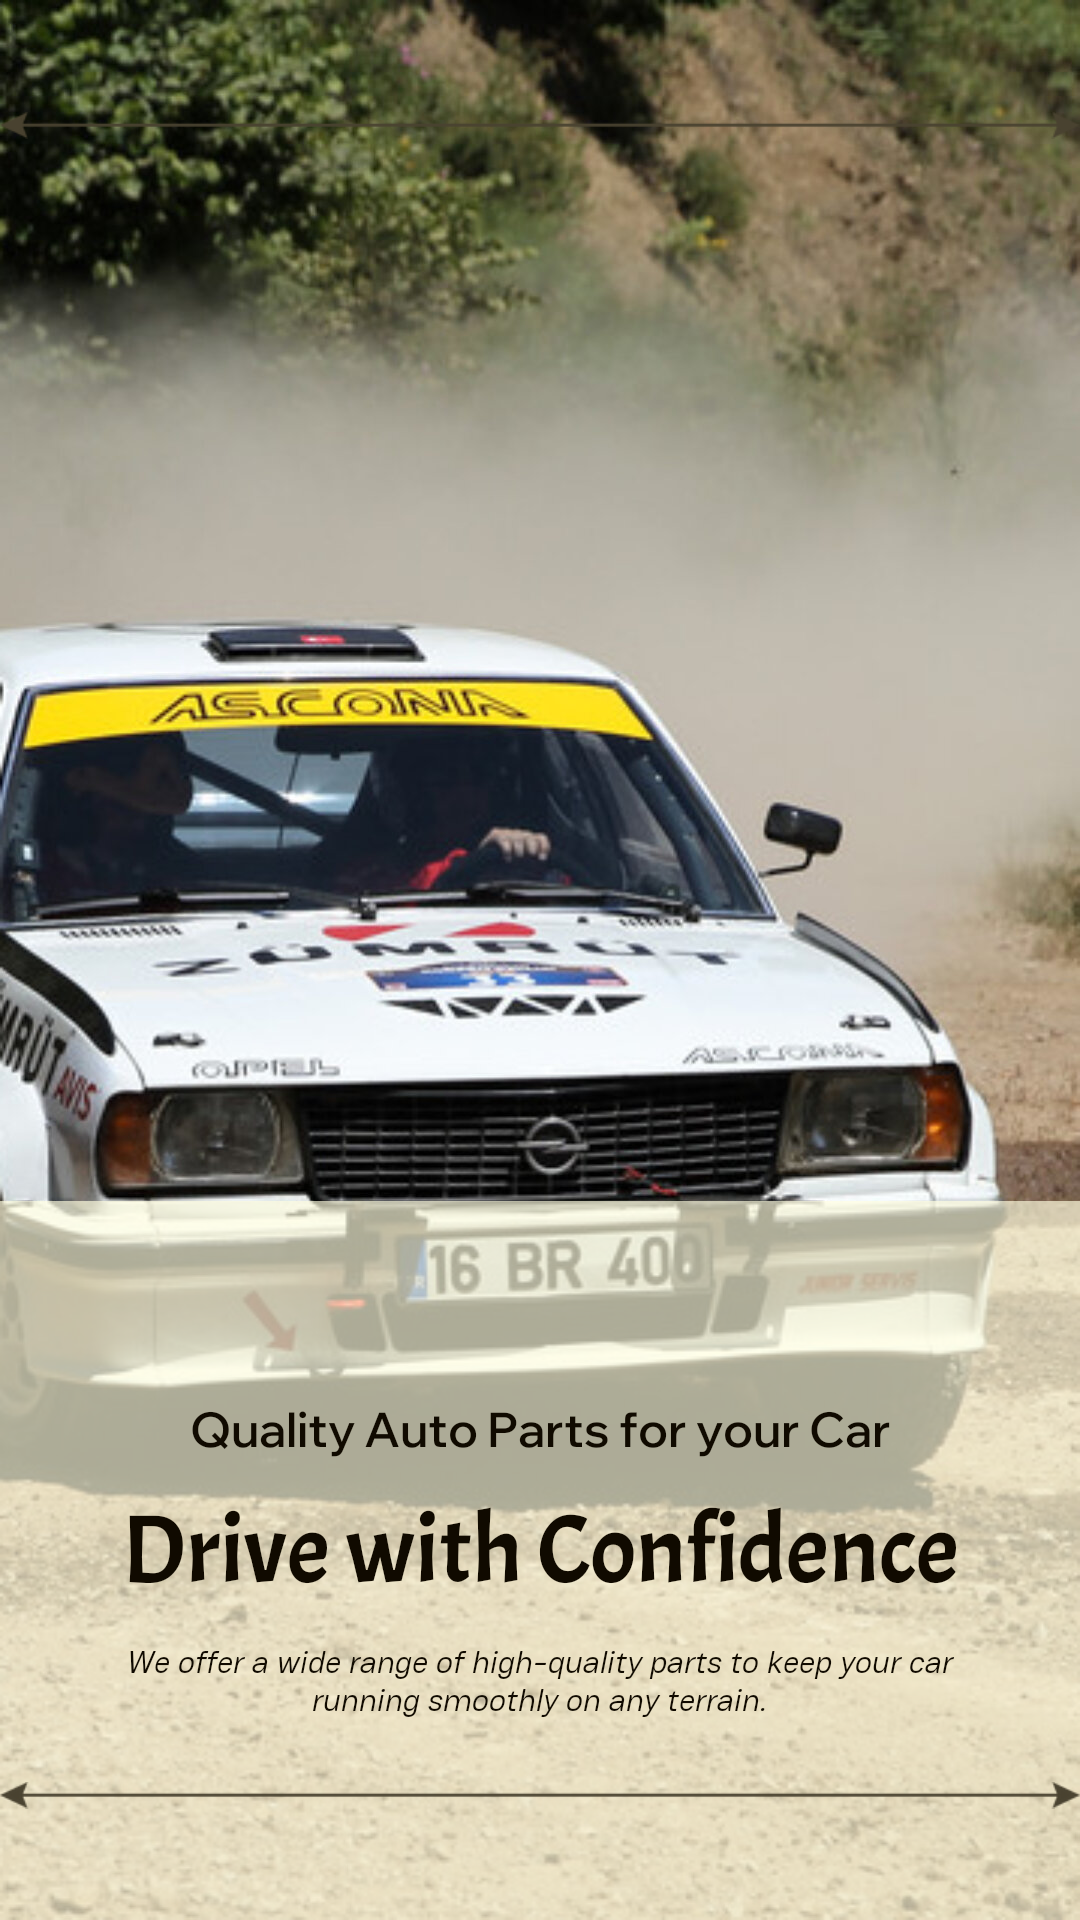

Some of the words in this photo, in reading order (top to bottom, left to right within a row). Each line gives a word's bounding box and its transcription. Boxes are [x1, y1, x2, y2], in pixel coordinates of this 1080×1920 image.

[151, 689, 529, 722] ASCONA
[0, 995, 67, 1096] MRÜT
[428, 1244, 482, 1294] 16
[507, 1239, 583, 1292] BR
[606, 1232, 702, 1288] 400
